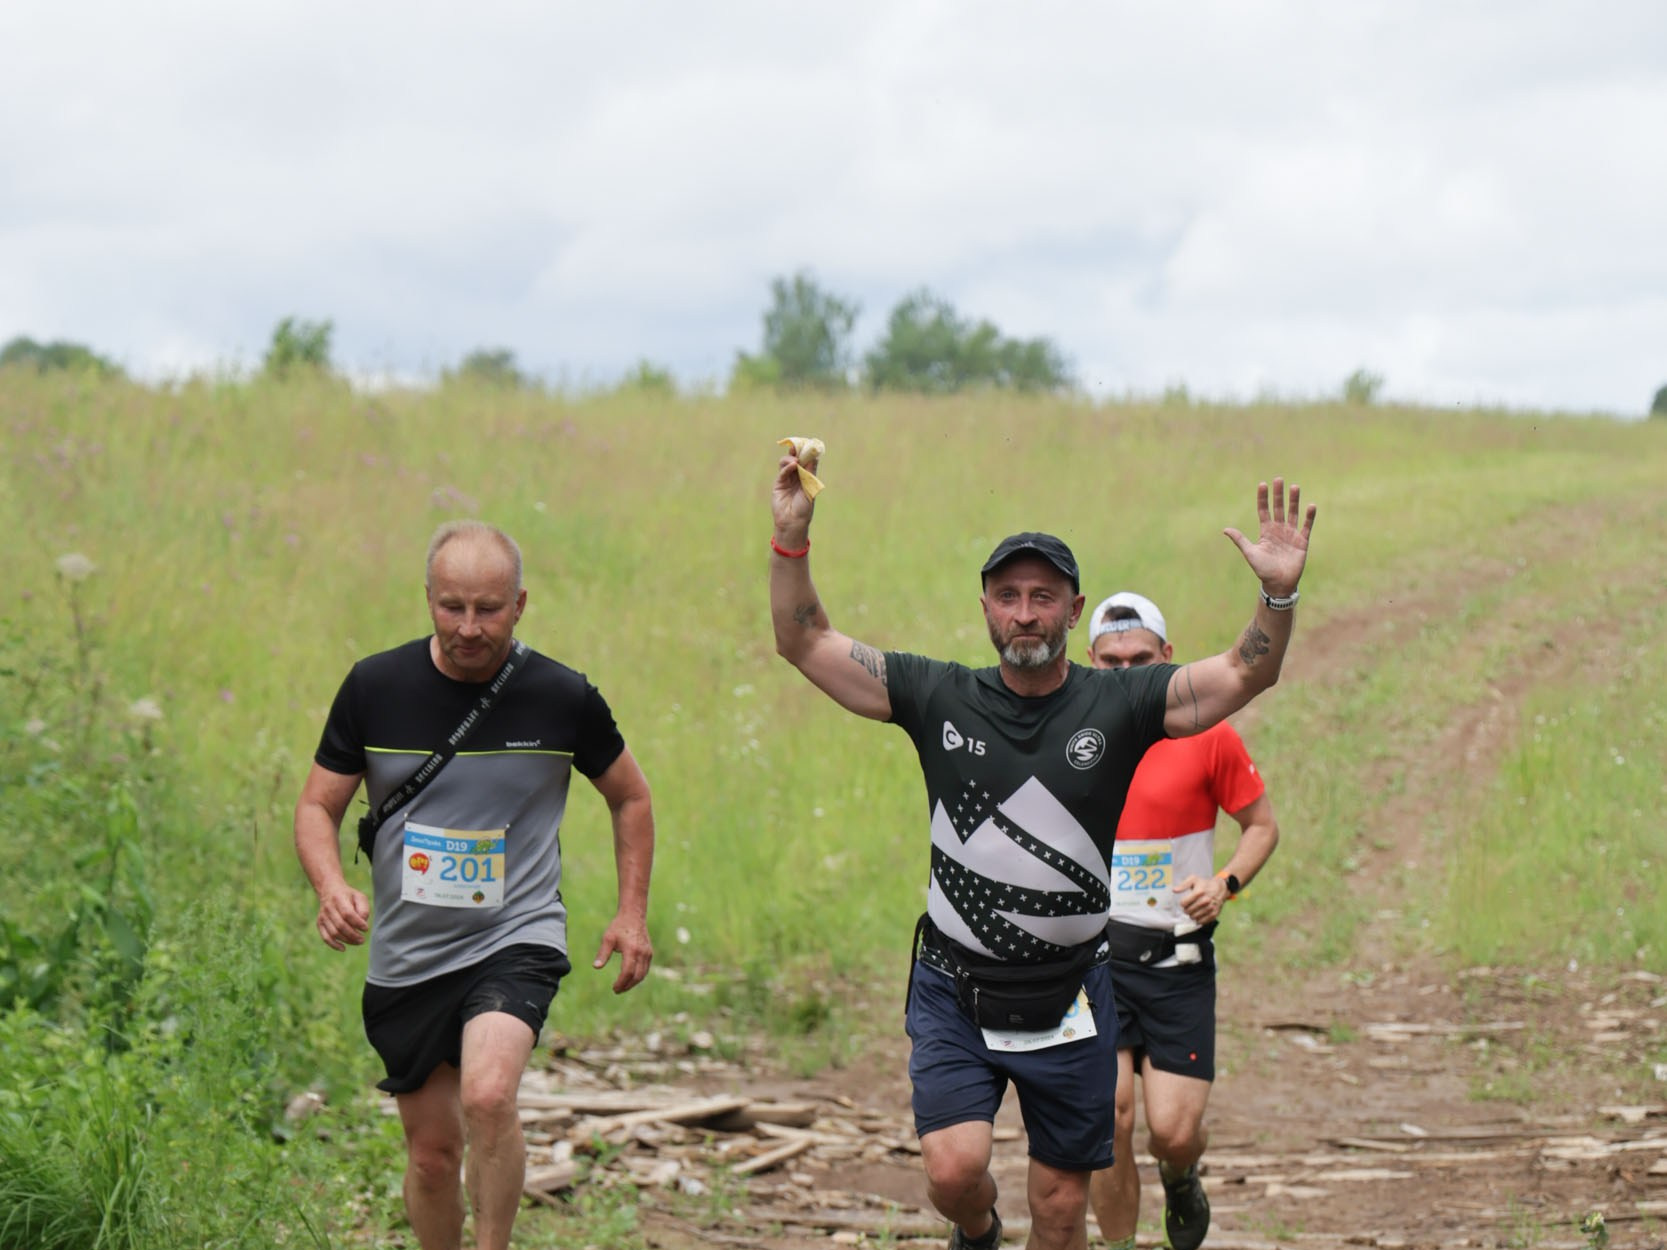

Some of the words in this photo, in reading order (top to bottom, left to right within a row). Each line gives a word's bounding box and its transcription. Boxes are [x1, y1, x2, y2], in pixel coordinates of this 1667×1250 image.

[967, 737, 986, 756] 15
[446, 840, 468, 852] D19
[439, 855, 496, 883] 201
[1117, 868, 1167, 891] 222
